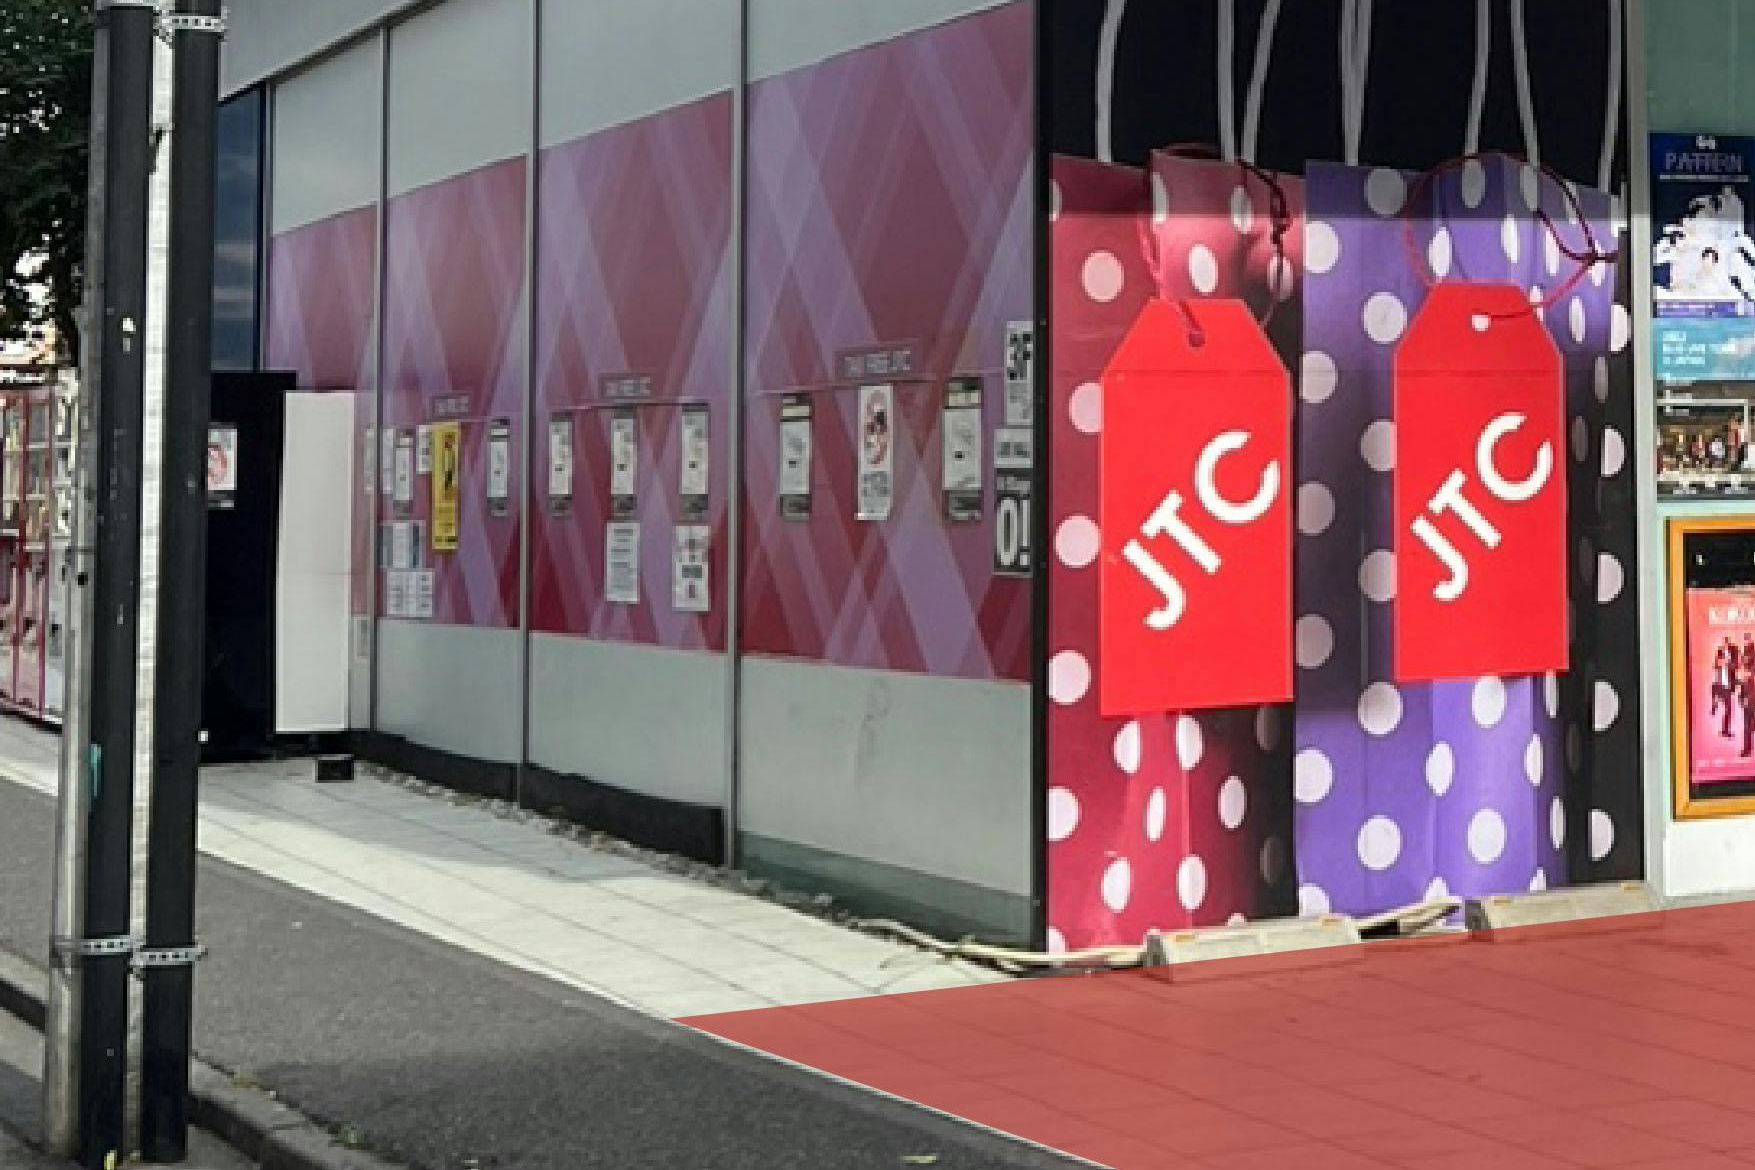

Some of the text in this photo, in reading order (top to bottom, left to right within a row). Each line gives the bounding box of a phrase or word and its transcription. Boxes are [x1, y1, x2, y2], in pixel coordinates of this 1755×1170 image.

[1664, 152, 1744, 174] PATTERN
[1121, 430, 1281, 630] JTC
[1410, 410, 1554, 602] JTC
